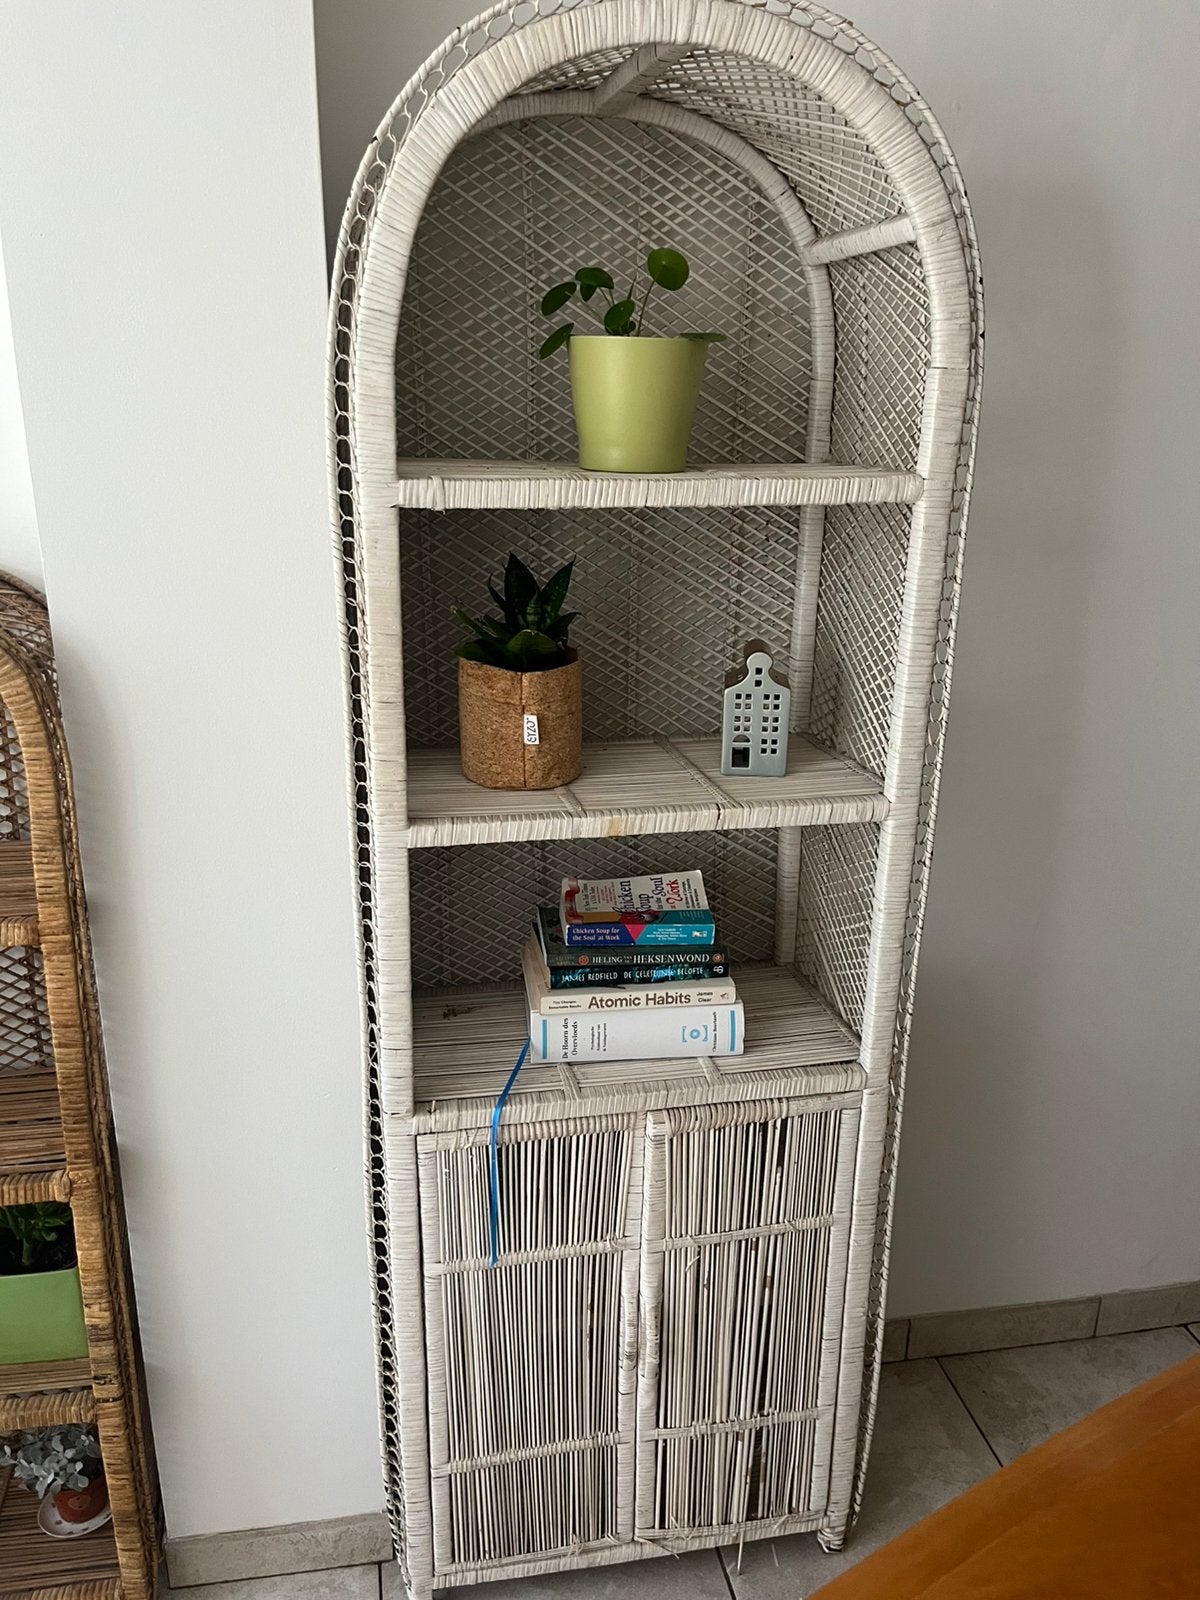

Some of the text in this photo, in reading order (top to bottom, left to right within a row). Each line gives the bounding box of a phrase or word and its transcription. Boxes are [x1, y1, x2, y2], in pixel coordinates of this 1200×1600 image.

[650, 876, 667, 897] Soul
[665, 879, 683, 905] Work
[612, 880, 637, 915] Chicken
[635, 893, 654, 913] Soup
[592, 956, 623, 964] HELING
[633, 953, 710, 964] HEKSENWOND
[561, 974, 585, 983] JAMES
[588, 972, 618, 981] REDFIELD
[623, 971, 632, 979] DE
[677, 967, 704, 976] BELOFTE
[588, 992, 691, 1009] Atomic Habits
[562, 1051, 569, 1059] De
